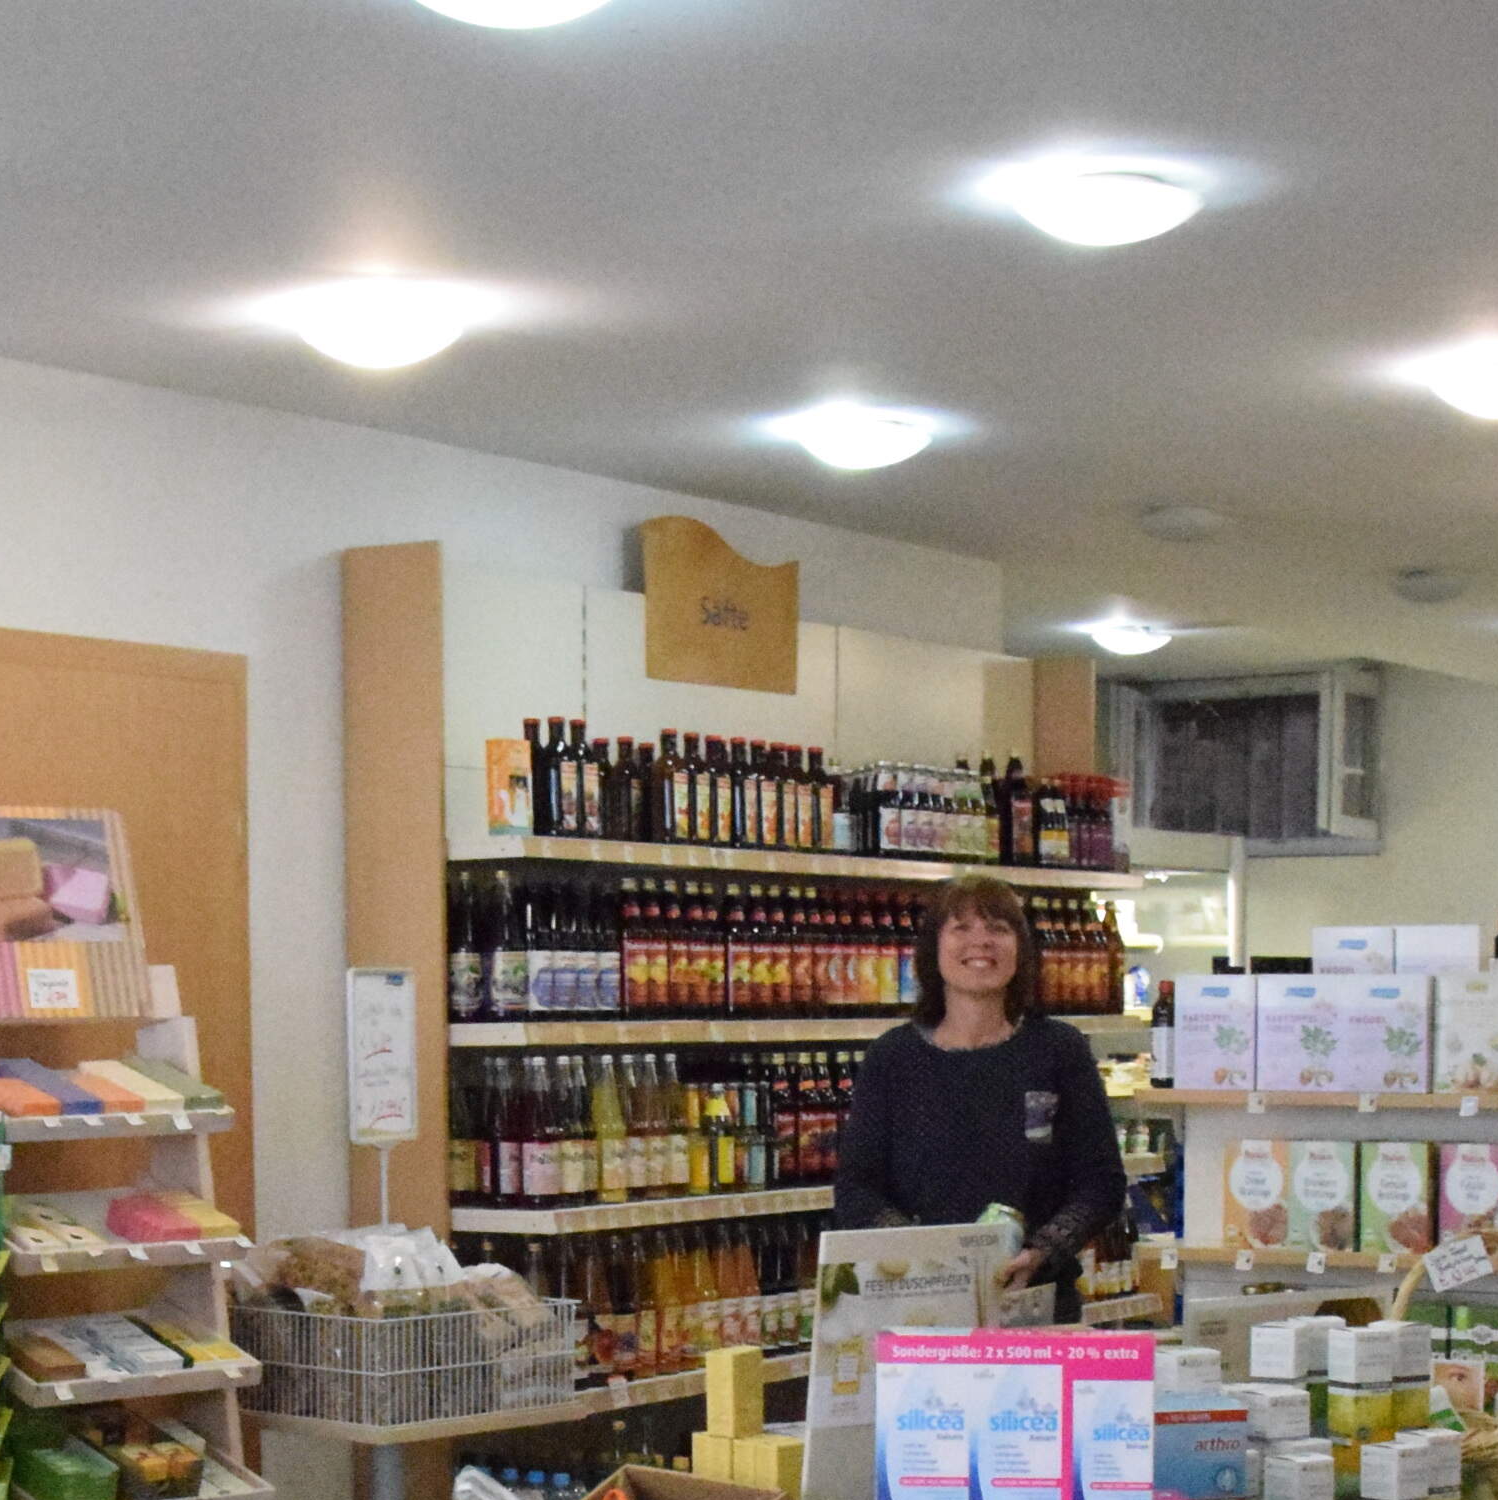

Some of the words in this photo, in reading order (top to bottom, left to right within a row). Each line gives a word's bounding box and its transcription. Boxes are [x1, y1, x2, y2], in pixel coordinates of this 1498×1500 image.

[891, 1345, 982, 1362] Sondergröße:
[985, 1346, 993, 1359] 2
[996, 1349, 1003, 1359] x
[1006, 1346, 1030, 1360] 500
[1032, 1345, 1052, 1360] ml
[1067, 1346, 1085, 1360] 20
[1086, 1346, 1101, 1360] %
[1104, 1347, 1140, 1361] extra
[896, 1408, 965, 1432] silicea
[989, 1408, 1058, 1433] silicea
[1093, 1422, 1150, 1442] silicea
[1193, 1438, 1241, 1452] arthro
